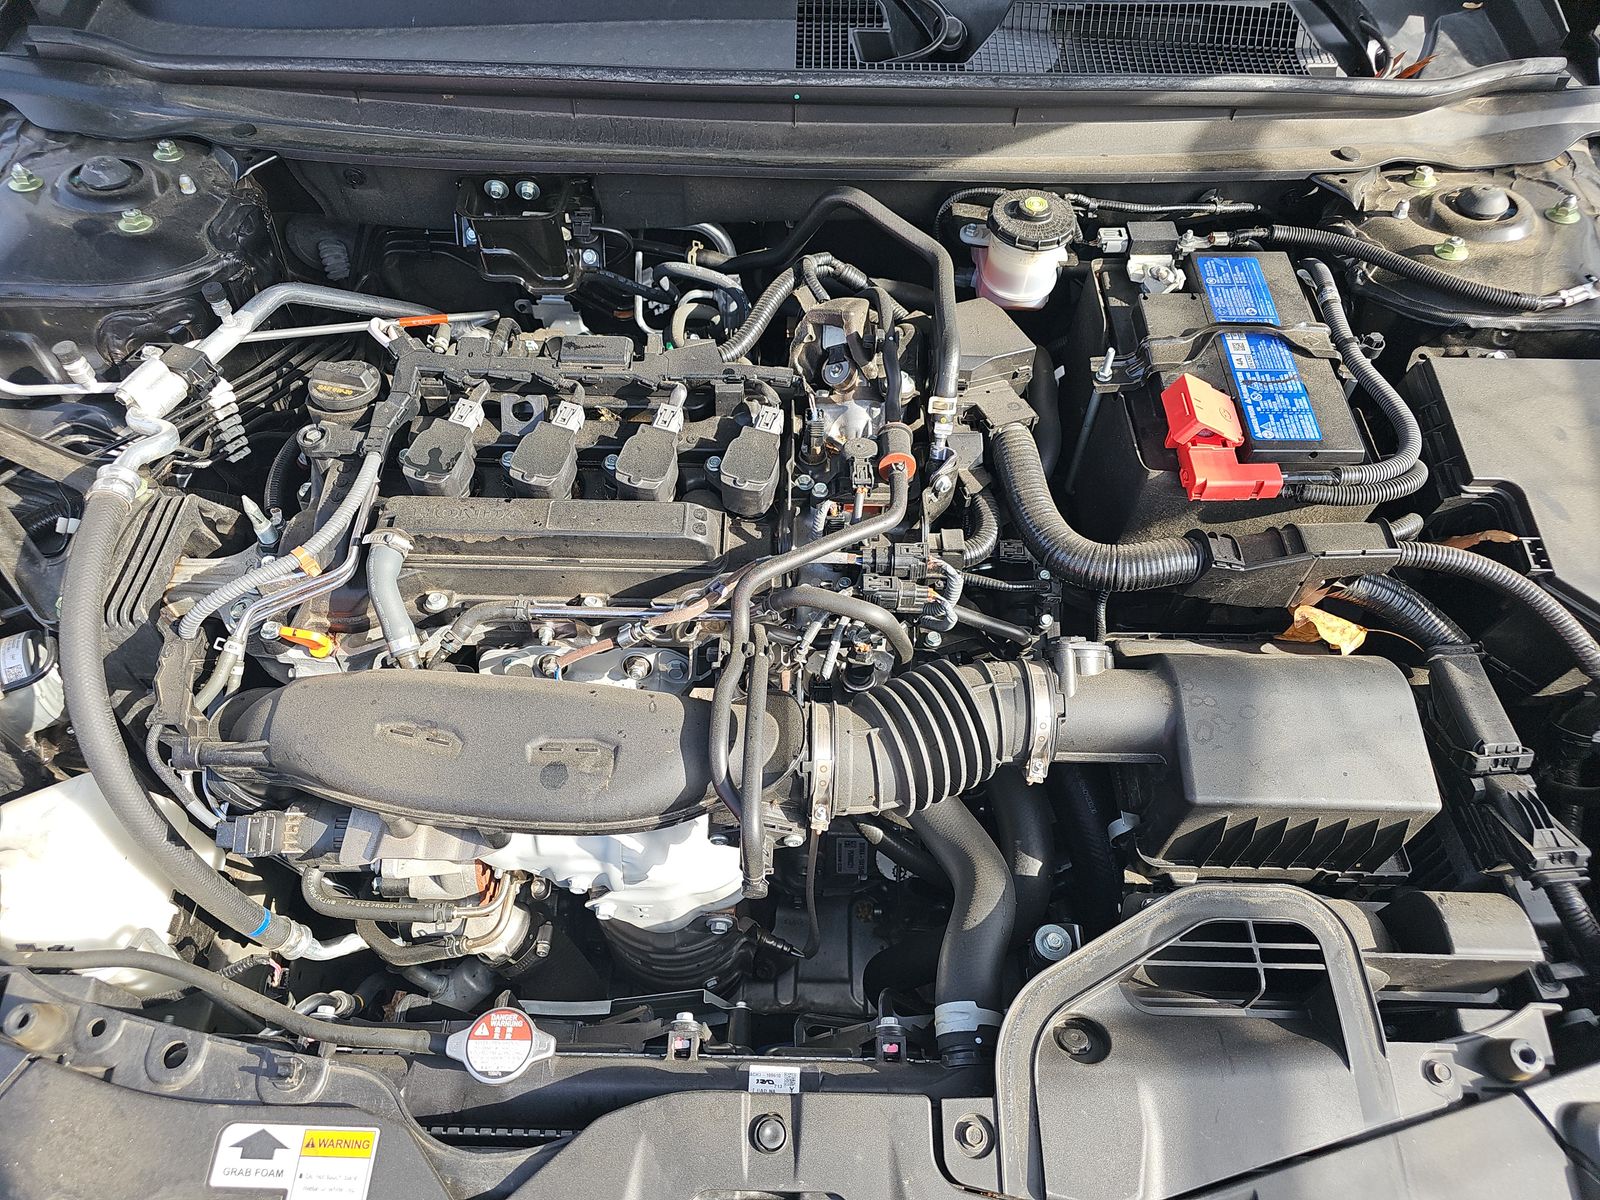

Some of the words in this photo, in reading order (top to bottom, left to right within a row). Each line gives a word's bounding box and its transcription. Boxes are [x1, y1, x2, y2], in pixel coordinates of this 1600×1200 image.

[318, 1138, 370, 1150] WARNING
[223, 1167, 251, 1177] GRAB
[255, 1168, 284, 1178] FOAM
